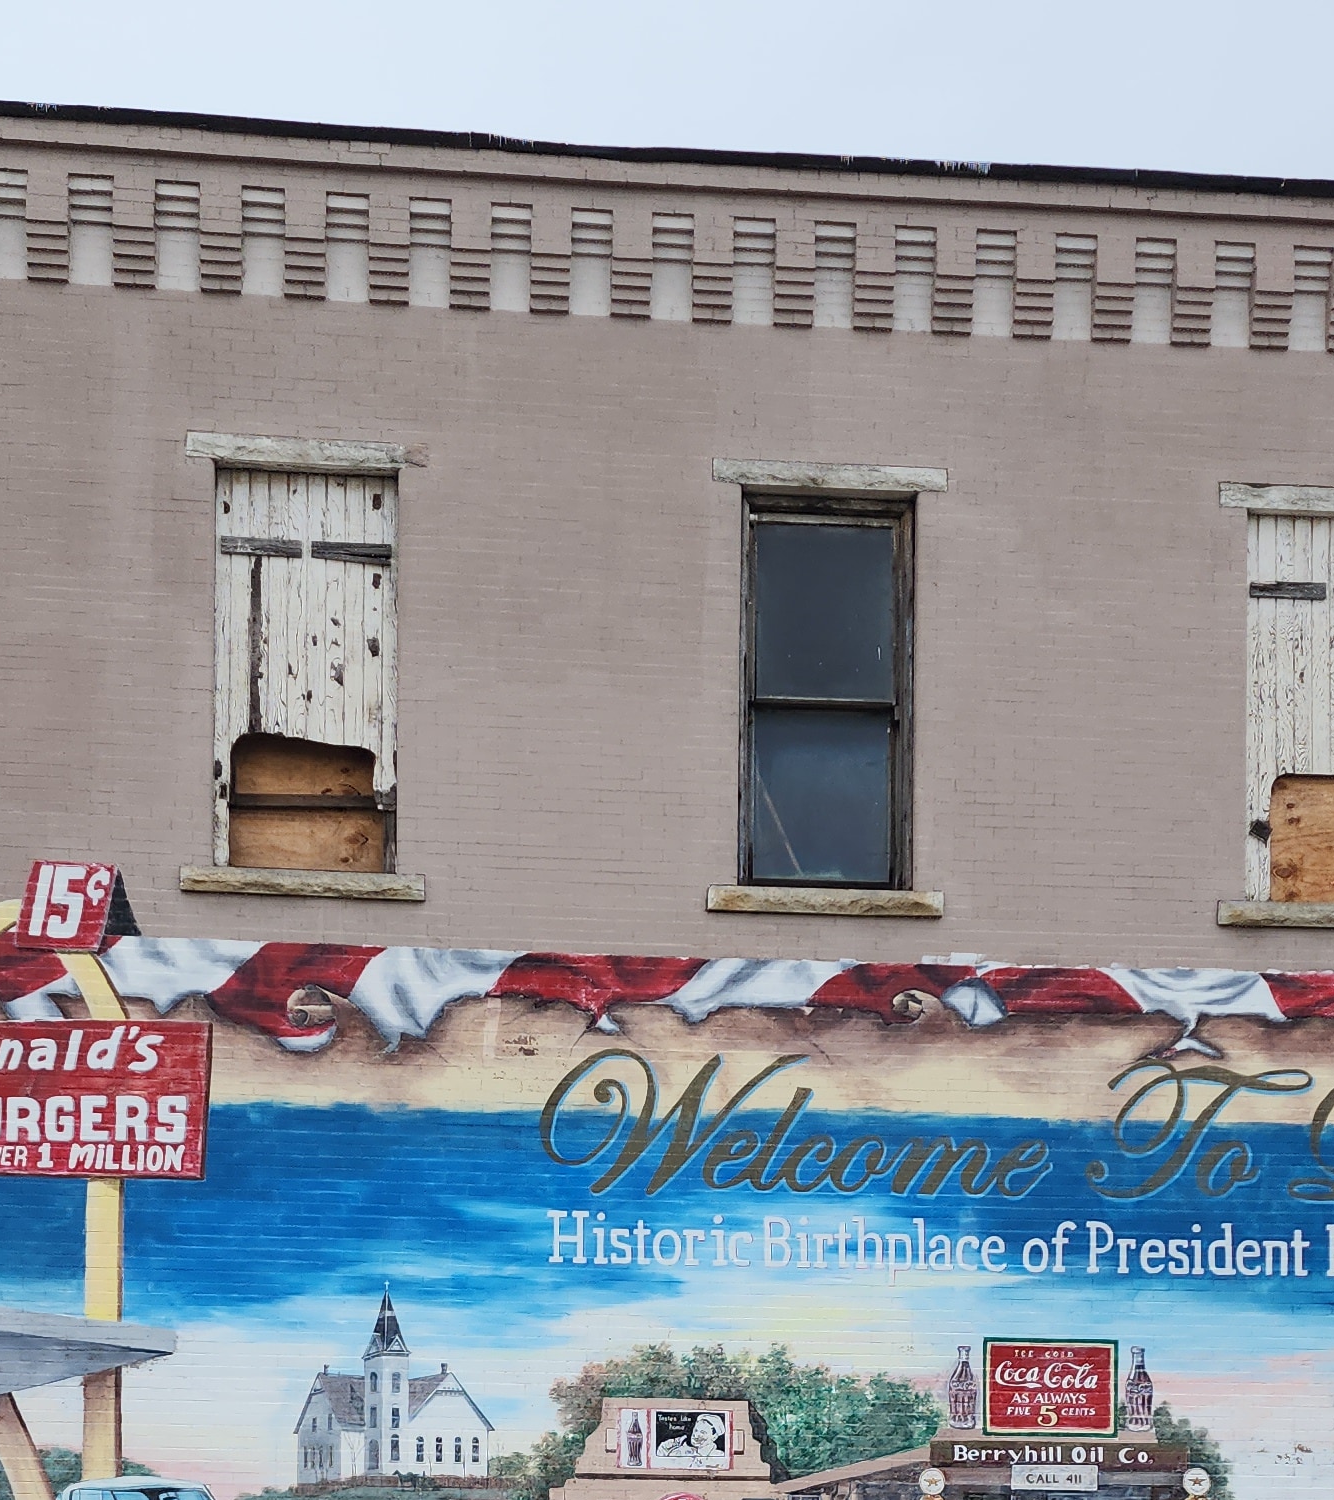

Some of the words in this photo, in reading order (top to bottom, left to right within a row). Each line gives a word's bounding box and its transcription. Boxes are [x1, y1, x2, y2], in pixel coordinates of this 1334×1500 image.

[28, 863, 111, 939] 15¢
[540, 1048, 1054, 1198] Welcome
[1085, 1057, 1314, 1200] To
[36, 1143, 54, 1169] 1
[546, 1210, 755, 1267] Historic
[763, 1216, 1008, 1284] Birthplace
[1022, 1221, 1085, 1273] of
[1087, 1220, 1310, 1280] President
[994, 1360, 1042, 1388] Coca
[1043, 1362, 1098, 1389] Cola
[1010, 1392, 1029, 1404] AS
[1033, 1392, 1087, 1404] ALWAYS
[1007, 1406, 1031, 1416] FIVE
[1036, 1405, 1059, 1427] 5
[1061, 1407, 1096, 1417] CENTS
[953, 1444, 1062, 1465] Berryhill
[1071, 1446, 1104, 1464] Oil
[1025, 1474, 1060, 1484] CALL
[1066, 1474, 1083, 1484] 411
